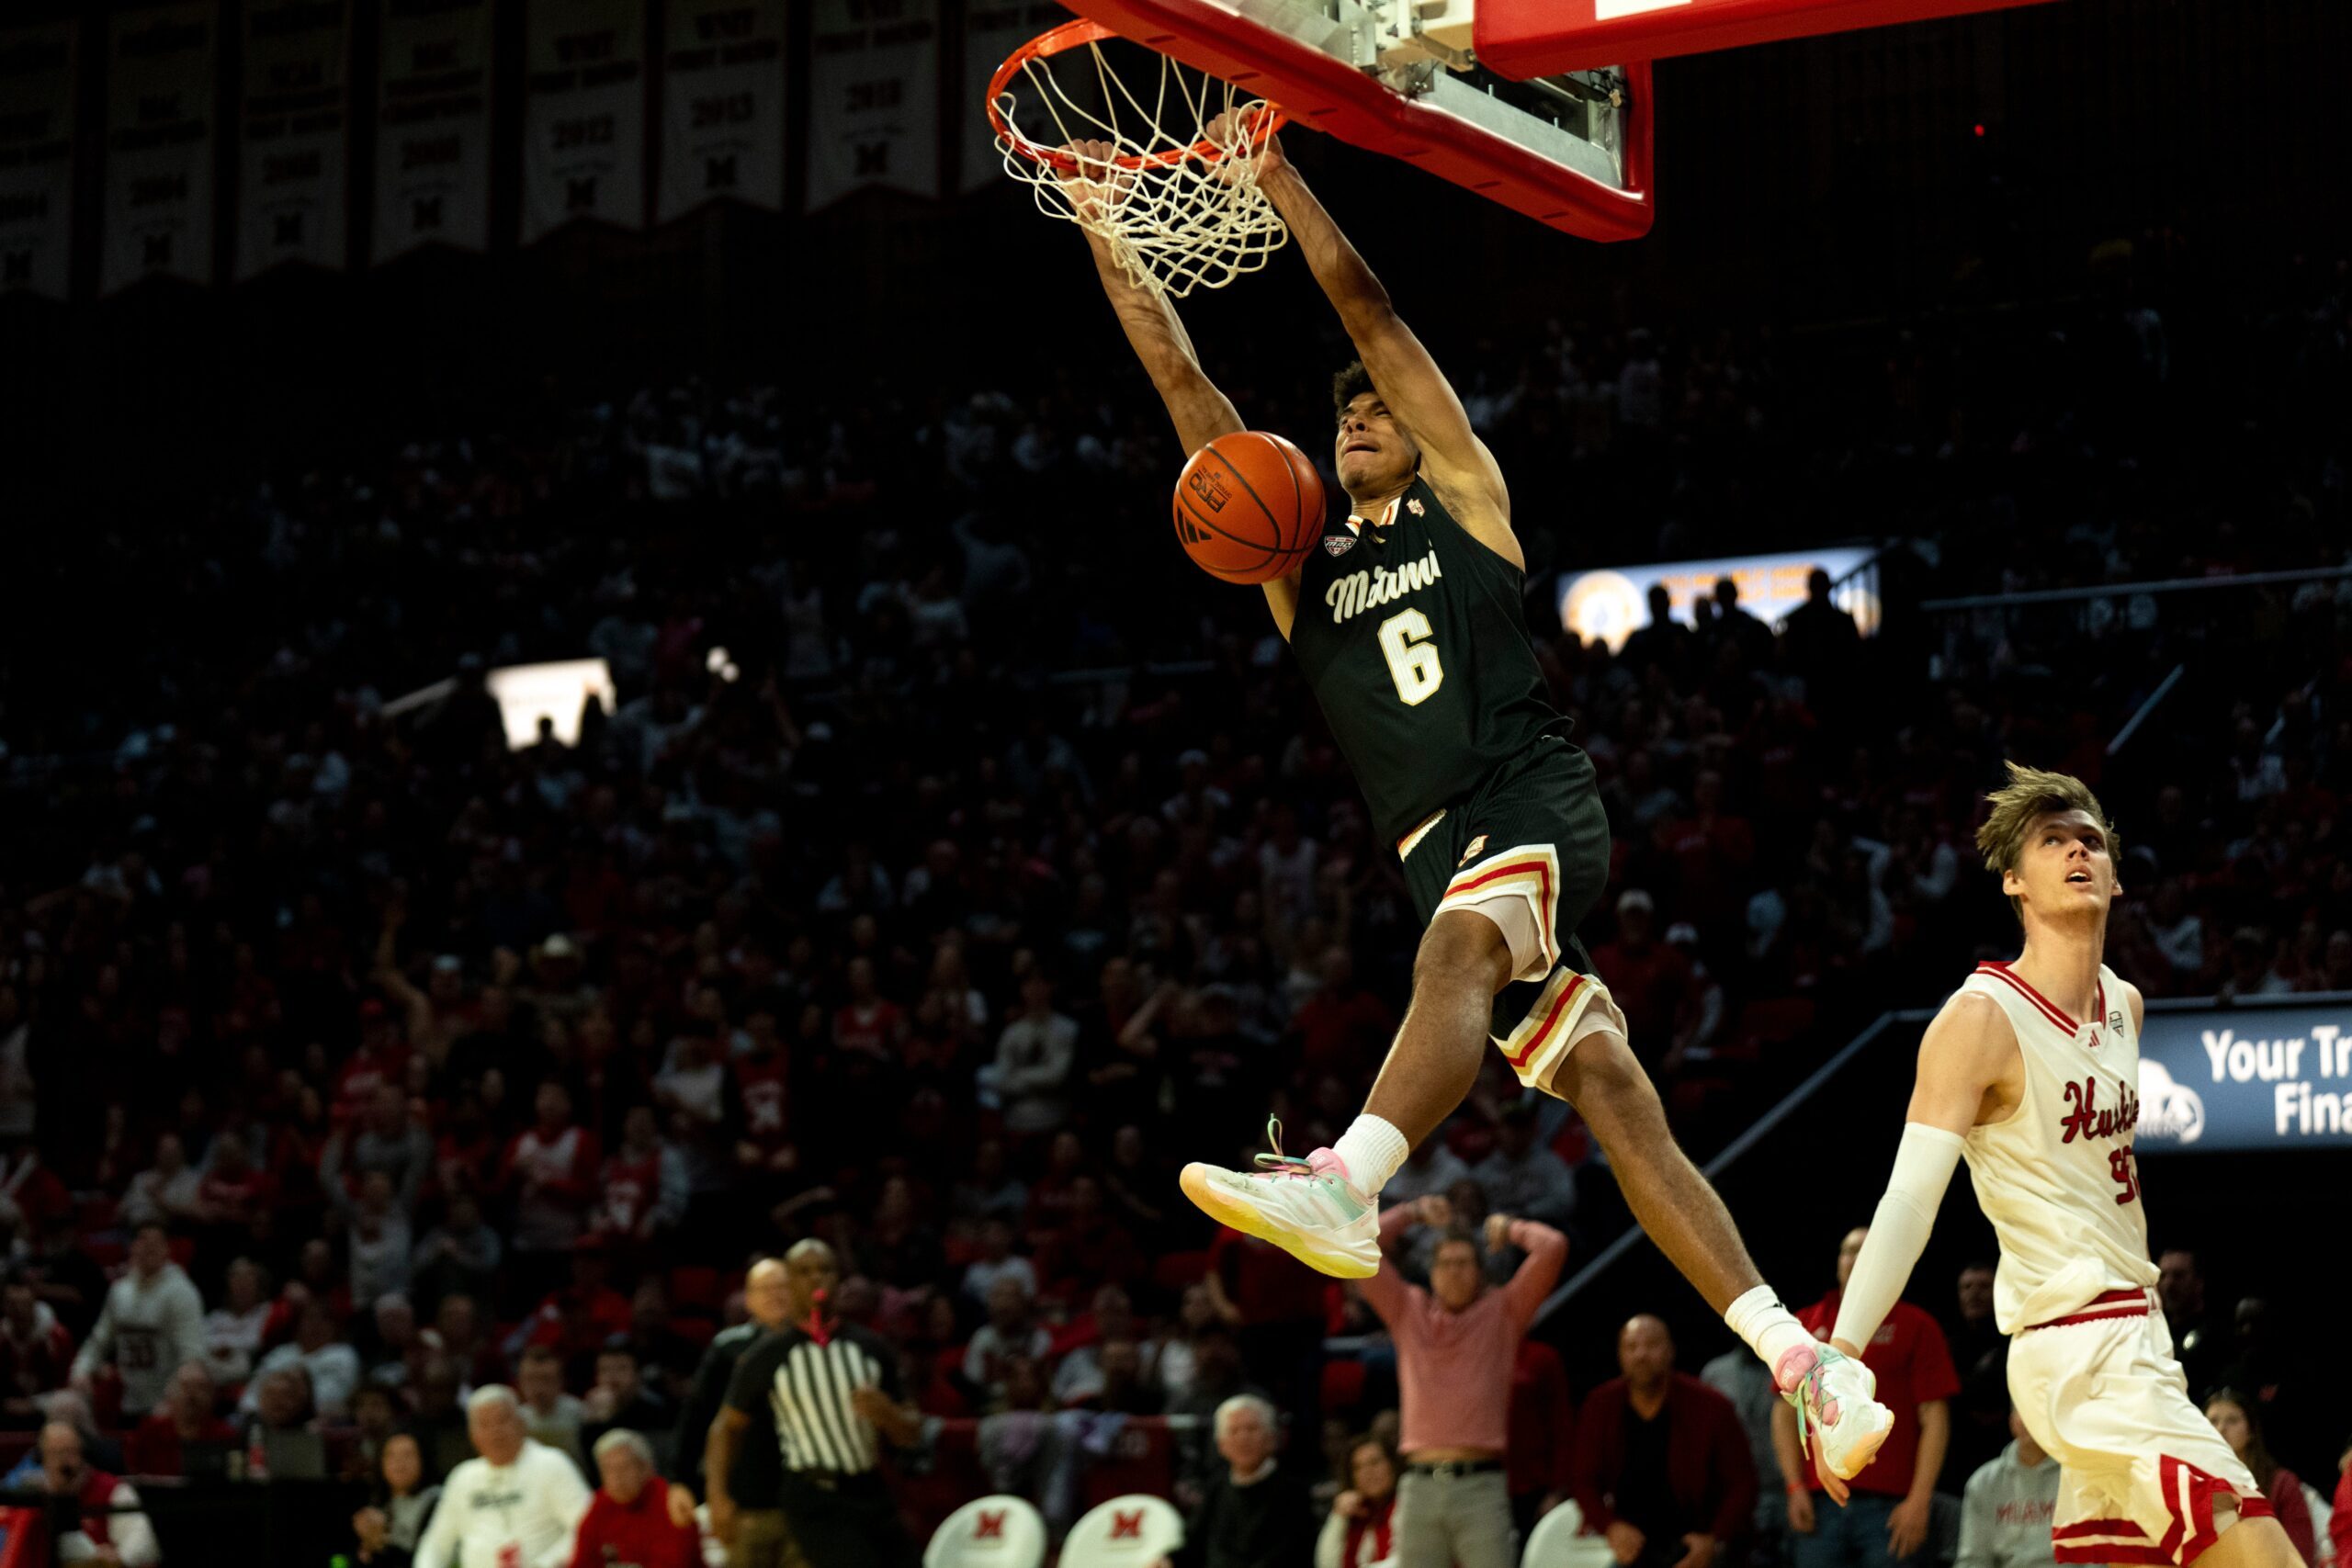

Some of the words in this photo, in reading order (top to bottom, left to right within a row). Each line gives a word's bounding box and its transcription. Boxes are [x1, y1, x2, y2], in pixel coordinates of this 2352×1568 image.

[1189, 472, 1227, 513] PRO
[1325, 540, 1442, 624] Miami
[1377, 607, 1444, 706] 6
[2200, 1029, 2305, 1083] Your
[974, 1509, 1007, 1540] M
[1110, 1508, 1145, 1540] M
